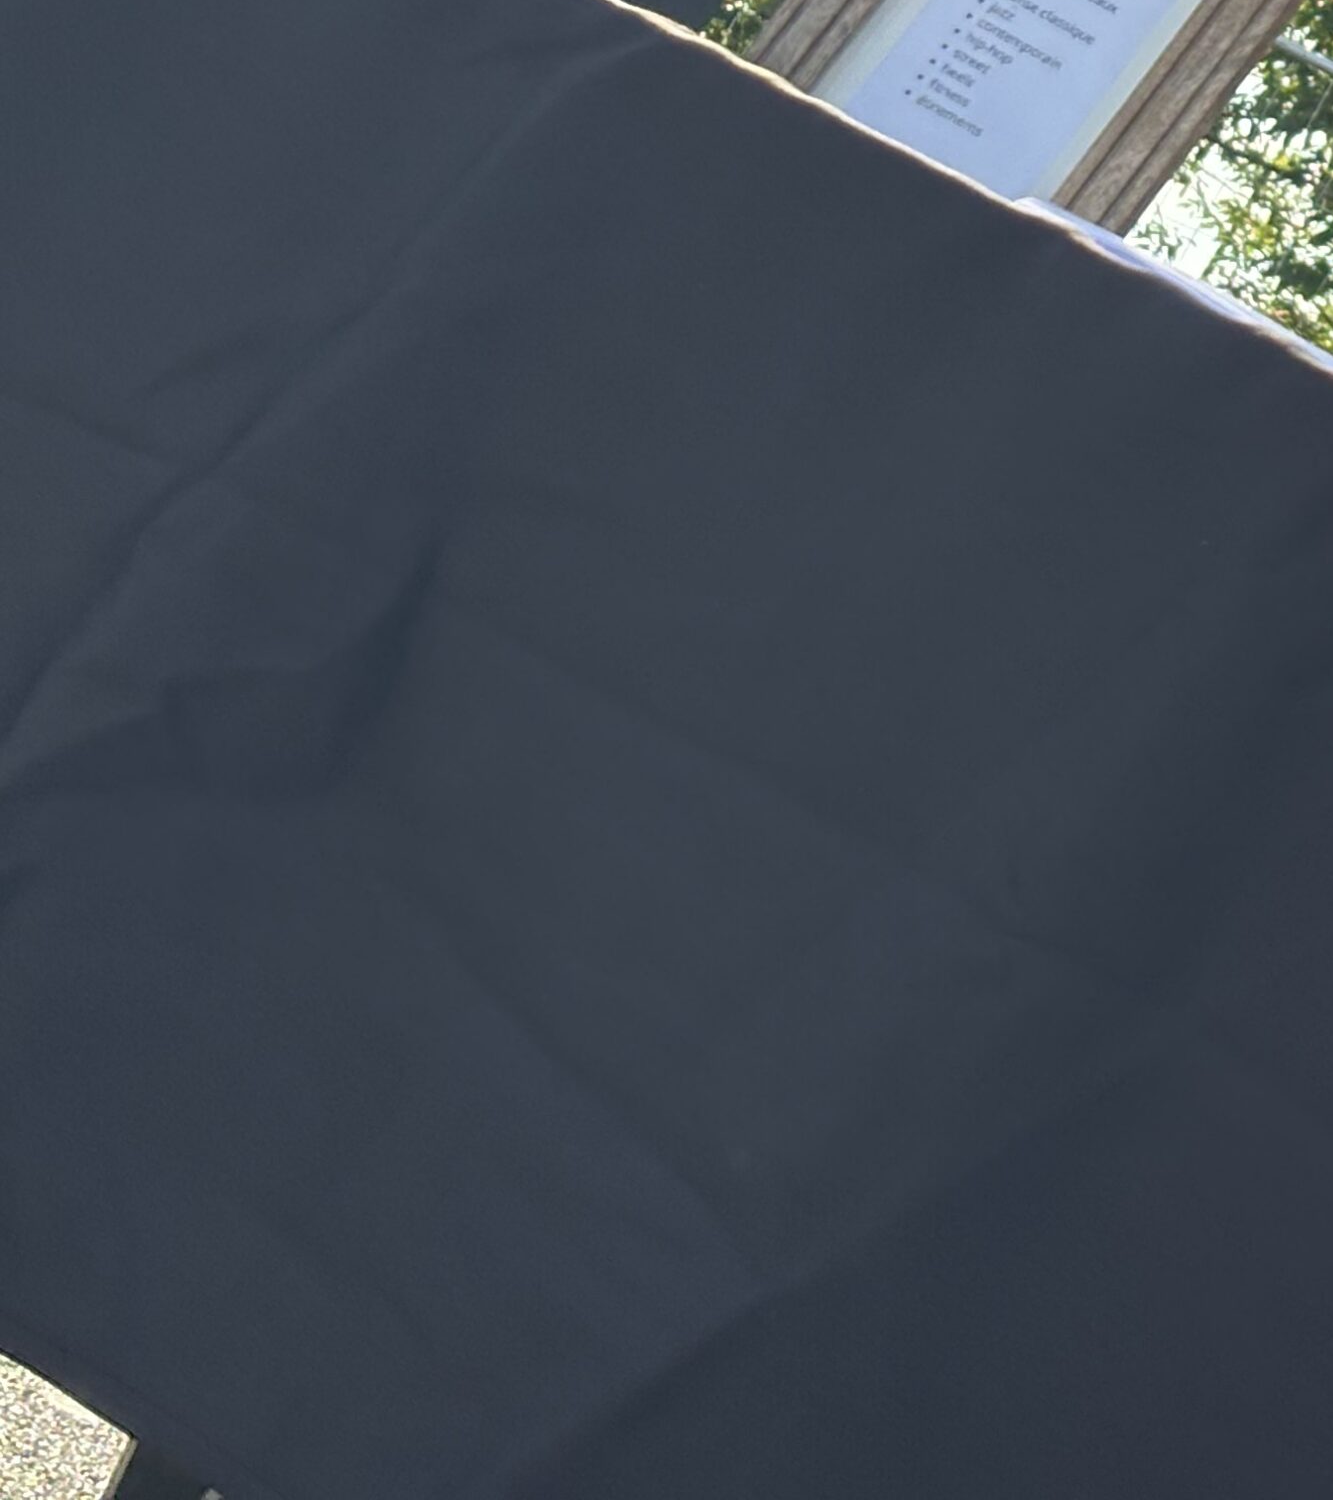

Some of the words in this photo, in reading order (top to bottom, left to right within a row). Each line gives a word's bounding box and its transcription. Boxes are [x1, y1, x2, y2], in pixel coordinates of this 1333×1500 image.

[985, 3, 1015, 21] jazz
[1038, 9, 1095, 45] classique
[952, 48, 991, 74] street
[965, 31, 1013, 65] hip-hop
[976, 19, 1062, 69] contemporain
